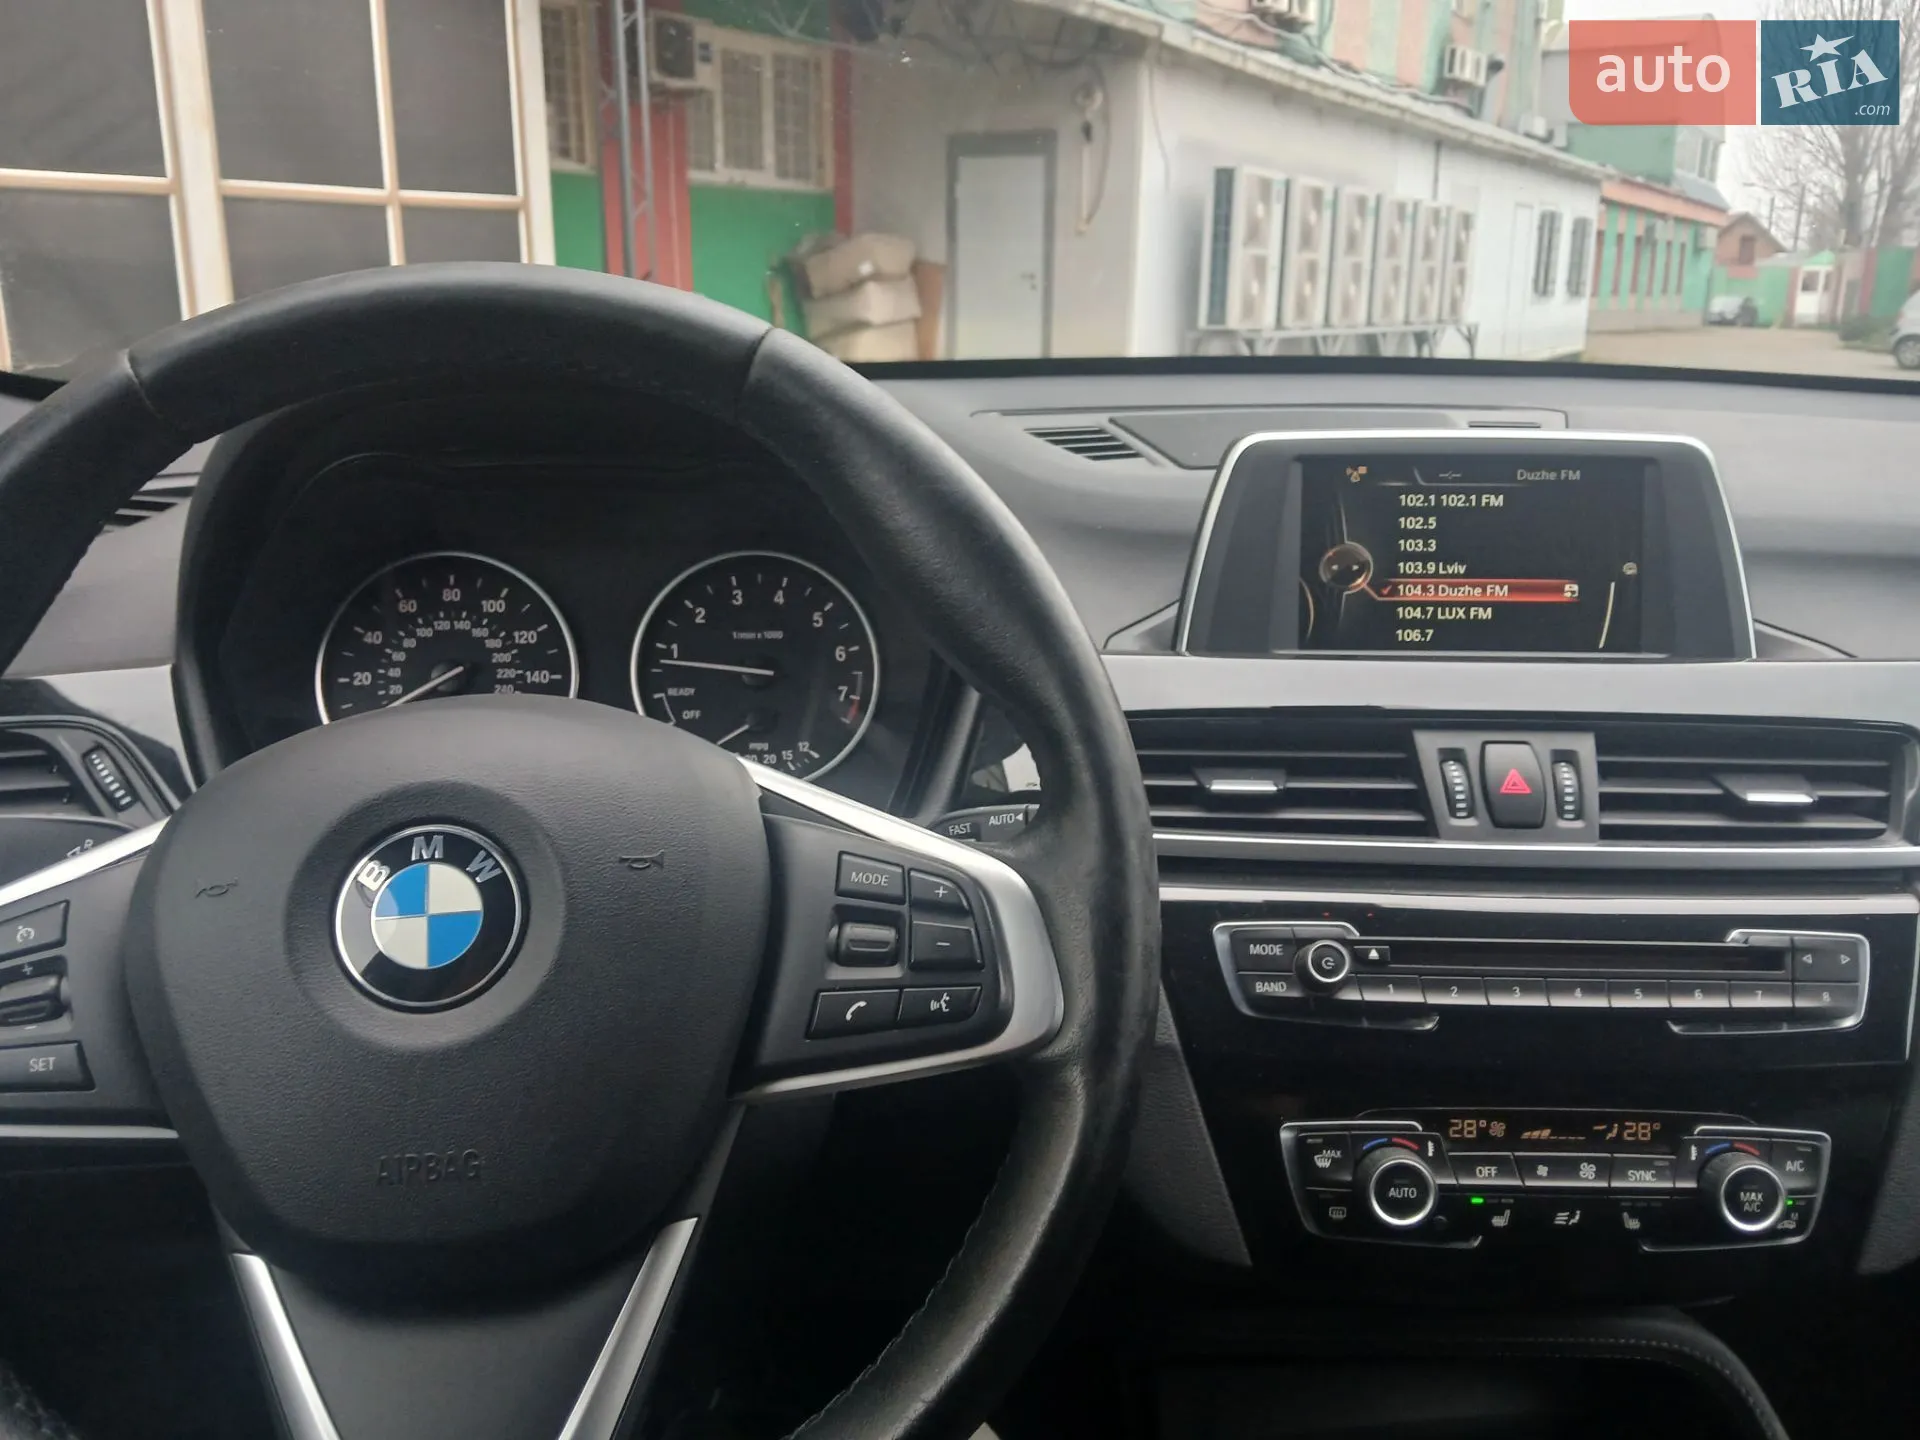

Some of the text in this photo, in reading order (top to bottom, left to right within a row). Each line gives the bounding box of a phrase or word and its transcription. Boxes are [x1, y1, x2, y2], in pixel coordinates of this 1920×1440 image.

[1517, 469, 1580, 481] Duzhe FM
[1399, 494, 1504, 507] 102.1 102.1 FM
[1398, 517, 1437, 529] 102.5
[1398, 539, 1437, 552] 103.3
[1397, 561, 1466, 574] 103.9 Lviv
[442, 588, 461, 601] 80
[1397, 584, 1508, 597] 104.3 Duzhe FM
[732, 589, 743, 605] 3
[774, 590, 784, 605] 4
[399, 600, 417, 612] 60
[481, 600, 506, 613] 100
[694, 607, 706, 623] 2
[1396, 607, 1492, 619] 104.7 LUX FM
[433, 620, 450, 630] 120
[453, 620, 471, 630] 140
[812, 612, 823, 627] 5
[363, 631, 383, 644] 40
[416, 627, 433, 638] 100
[513, 631, 538, 644] 120
[1395, 629, 1434, 642] 106.7
[402, 638, 417, 648] 80
[485, 638, 502, 648] 180
[391, 651, 406, 662] 60
[670, 643, 678, 659] 1
[835, 646, 846, 661] 6
[491, 652, 511, 663] 200
[353, 672, 372, 685] 20
[387, 667, 401, 678] 40
[497, 668, 515, 678] 220
[525, 671, 550, 684] 140
[389, 684, 403, 695] 20
[667, 687, 695, 696] READY
[838, 686, 848, 701] 7
[682, 710, 702, 720] OFF
[798, 741, 810, 752] 12
[763, 754, 777, 764] 20
[781, 750, 793, 761] 15
[988, 813, 1015, 827] AUTO
[948, 822, 972, 836] FAST
[357, 835, 503, 892] BMW
[851, 871, 890, 887] MODE
[1249, 944, 1284, 956] MODE
[1255, 981, 1287, 993] BAND
[1387, 984, 1394, 994] 1
[1450, 986, 1458, 997] 2
[1513, 986, 1521, 997] 3
[1574, 988, 1582, 999] 4
[1634, 989, 1642, 1000] 5
[1695, 989, 1703, 1001] 6
[1755, 990, 1763, 1001] 7
[29, 1057, 56, 1072] SET
[1322, 1150, 1342, 1158] MAX
[1476, 1166, 1498, 1178] OFF
[1785, 1161, 1805, 1172] A/C
[1627, 1171, 1657, 1182] SYNC
[1388, 1187, 1417, 1199] AUTO
[1740, 1191, 1763, 1203] MAX
[1743, 1202, 1761, 1213] A/C
